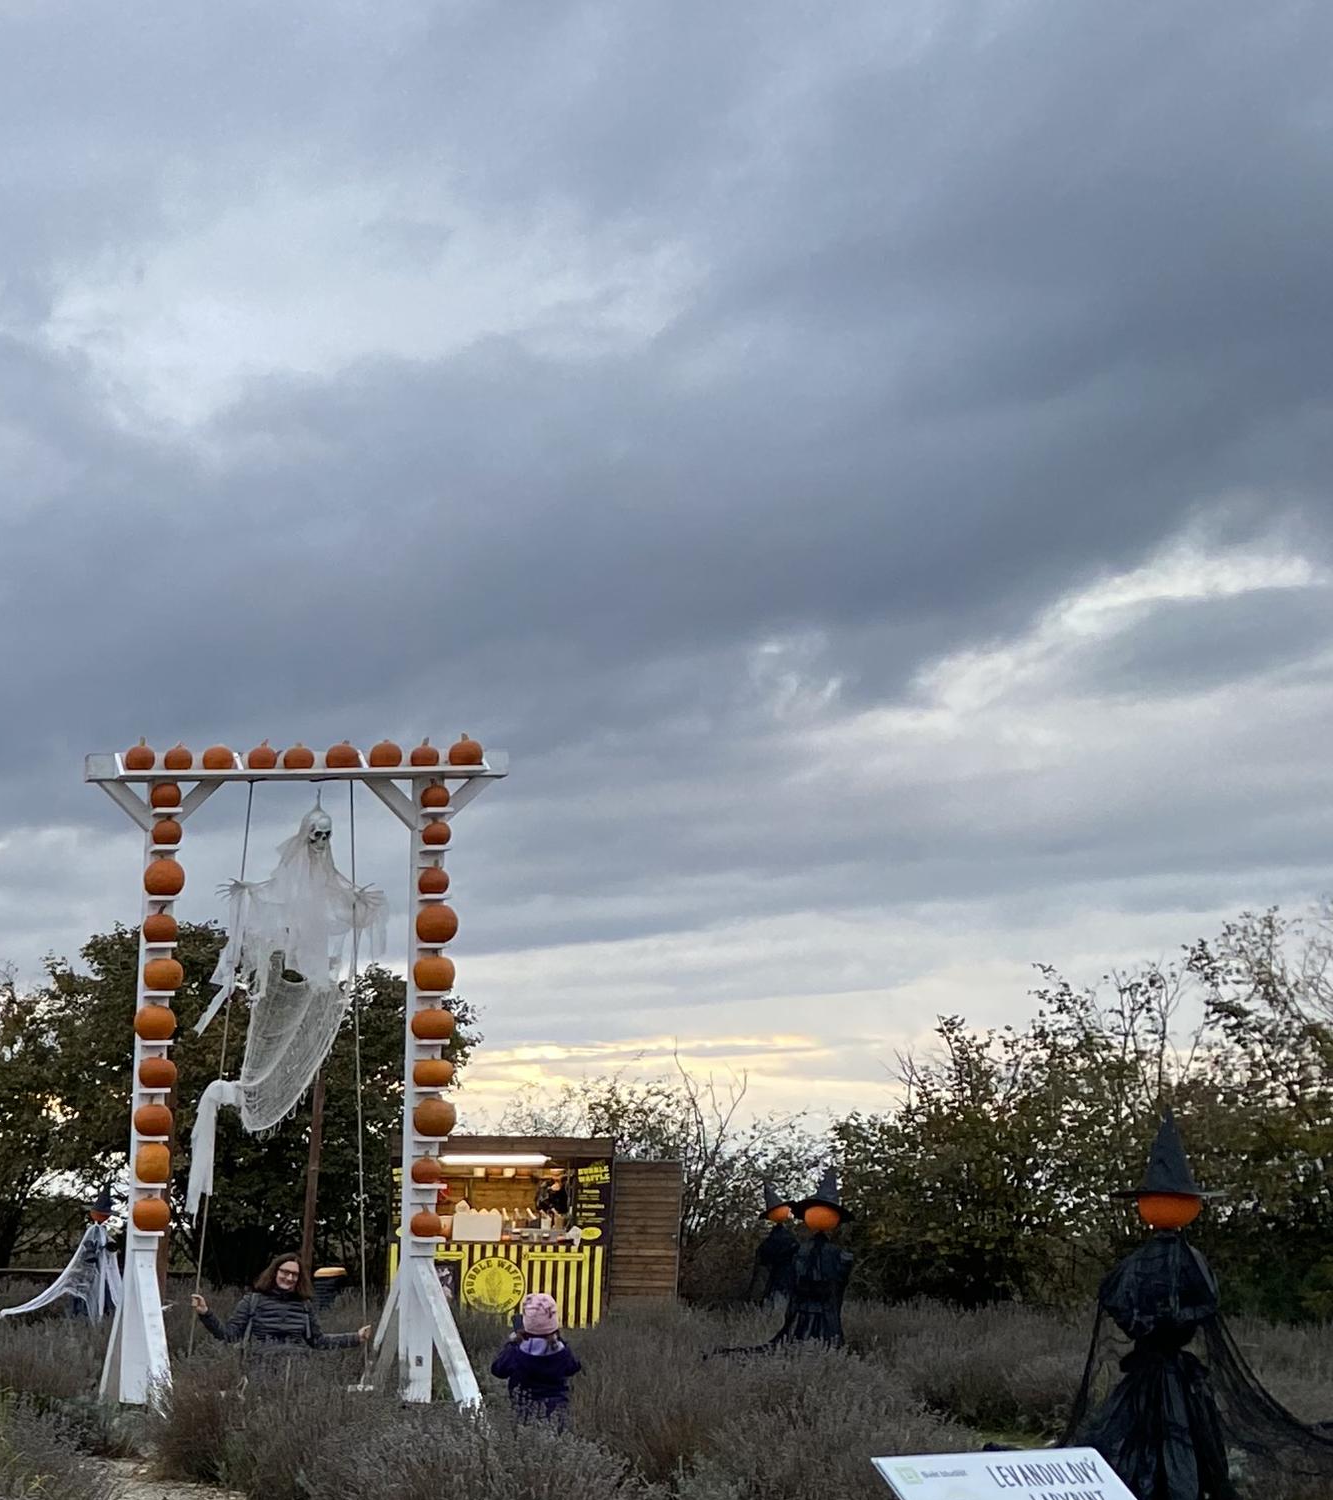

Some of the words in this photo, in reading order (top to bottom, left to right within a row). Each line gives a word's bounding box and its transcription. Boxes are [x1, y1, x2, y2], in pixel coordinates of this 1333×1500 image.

[466, 1259, 493, 1295] BUBBLE
[497, 1260, 522, 1296] WAFFLE
[985, 1457, 1105, 1488] LEVANDULOVÝ
